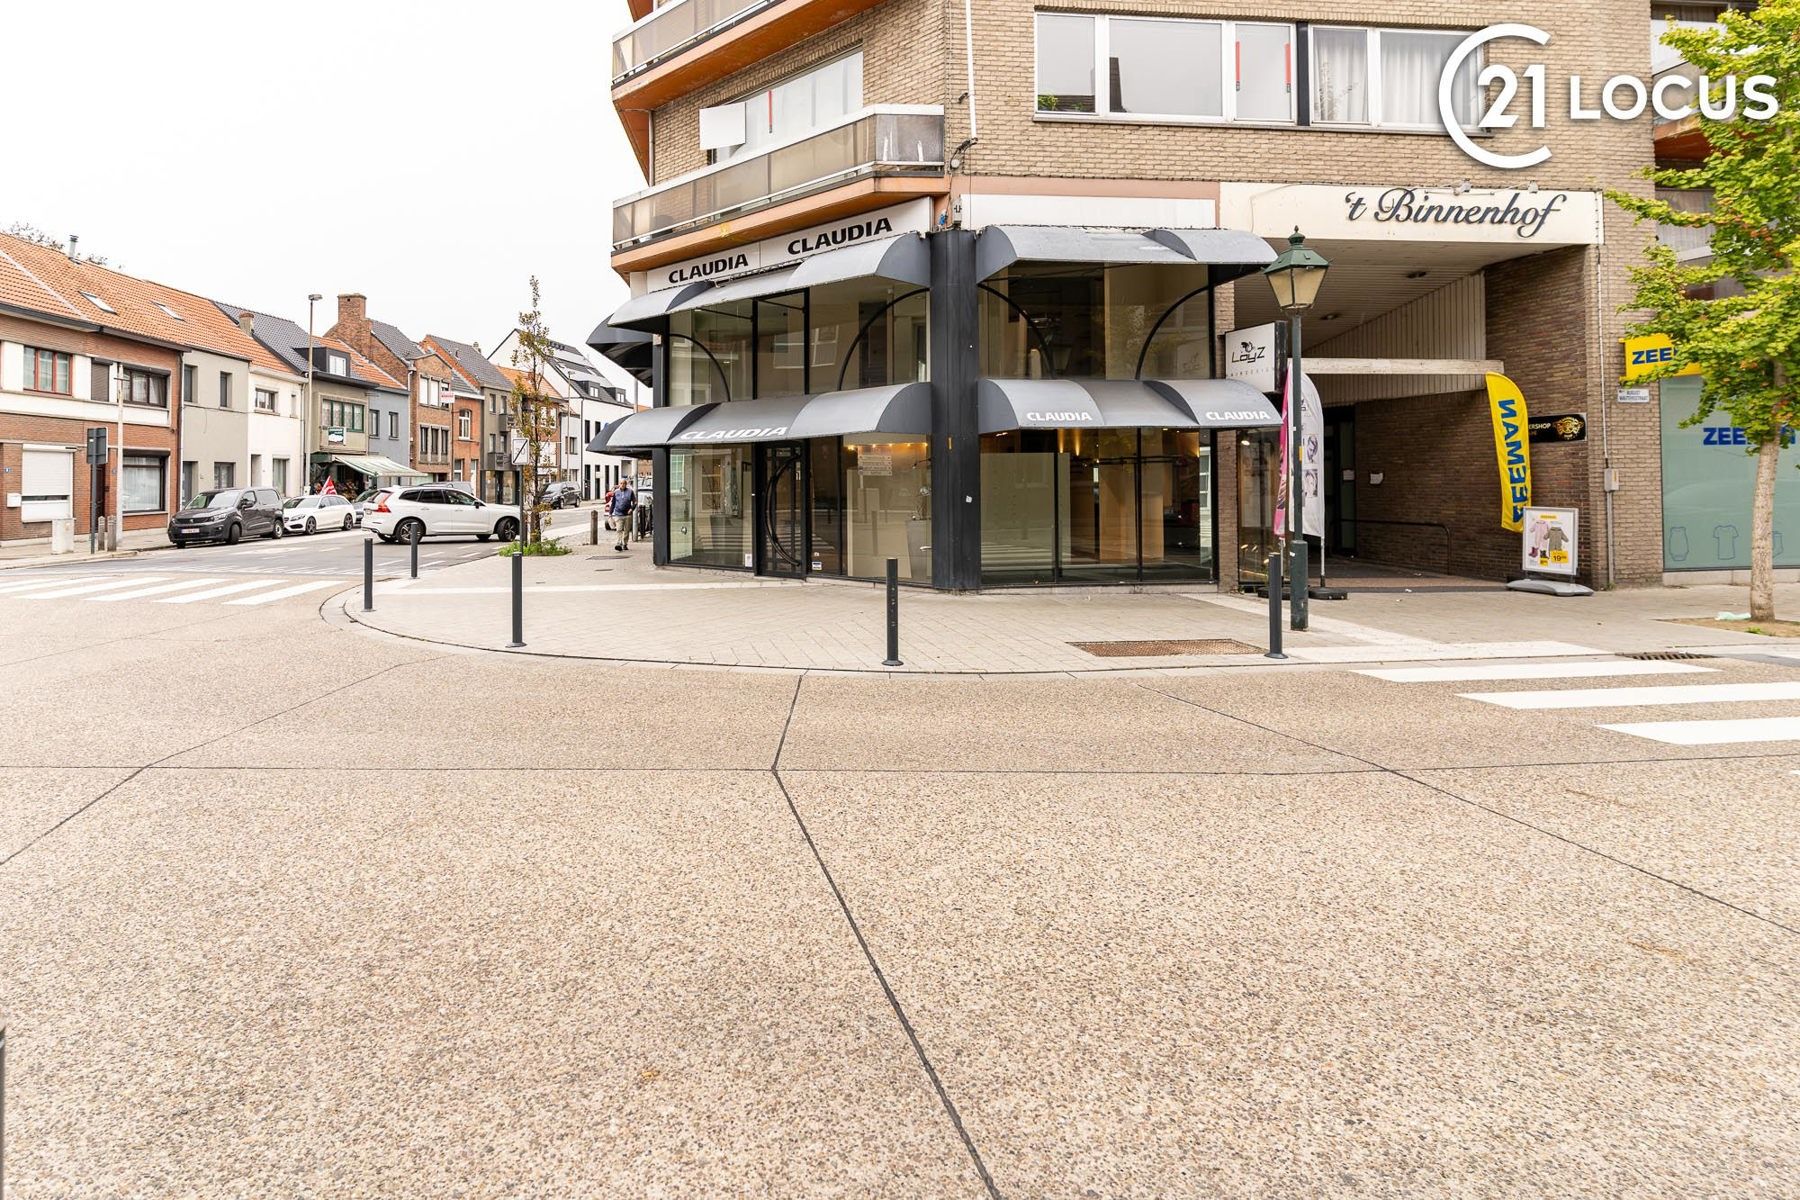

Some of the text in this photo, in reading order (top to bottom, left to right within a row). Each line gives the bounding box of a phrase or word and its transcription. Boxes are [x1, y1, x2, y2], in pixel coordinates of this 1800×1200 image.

[1373, 187, 1567, 238] Binnenhof
[787, 217, 893, 255] CLAUDIA
[668, 253, 749, 284] CLAUDIA
[1632, 346, 1674, 365] ZEE
[1026, 411, 1092, 422] CLAUDIA
[1205, 410, 1271, 421] CLAUDIA
[680, 426, 788, 440] CLAUDIA
[1529, 422, 1552, 430] ERSHOP
